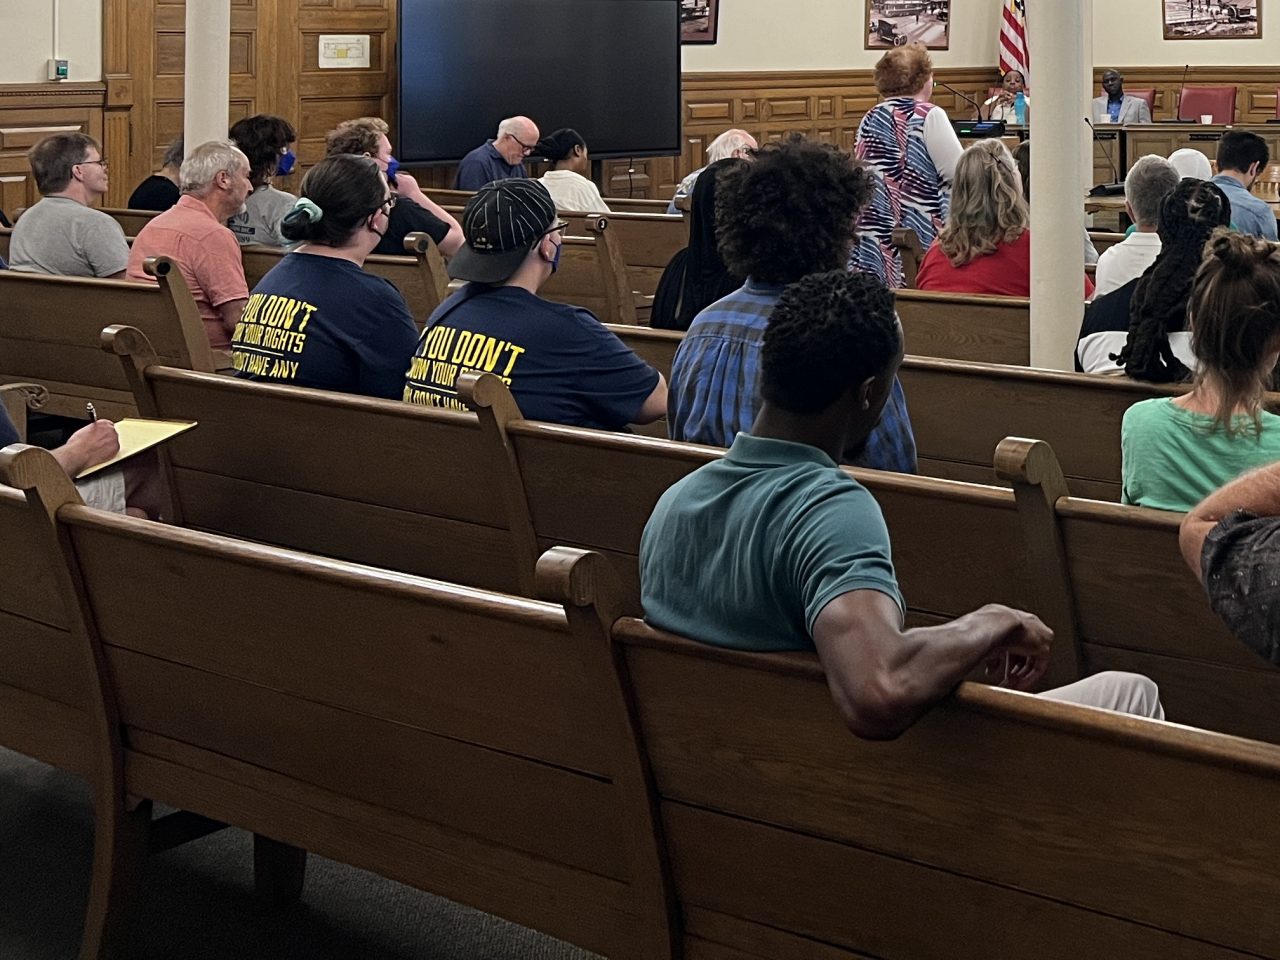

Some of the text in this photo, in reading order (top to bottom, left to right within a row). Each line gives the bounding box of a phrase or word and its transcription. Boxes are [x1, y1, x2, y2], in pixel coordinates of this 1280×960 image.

[260, 294, 318, 332] DON'T
[262, 326, 306, 353] RIGHTS
[421, 325, 525, 377] YOU DON'T
[247, 352, 270, 376] HAVE
[269, 359, 299, 378] ANY
[430, 360, 458, 387] YOUR
